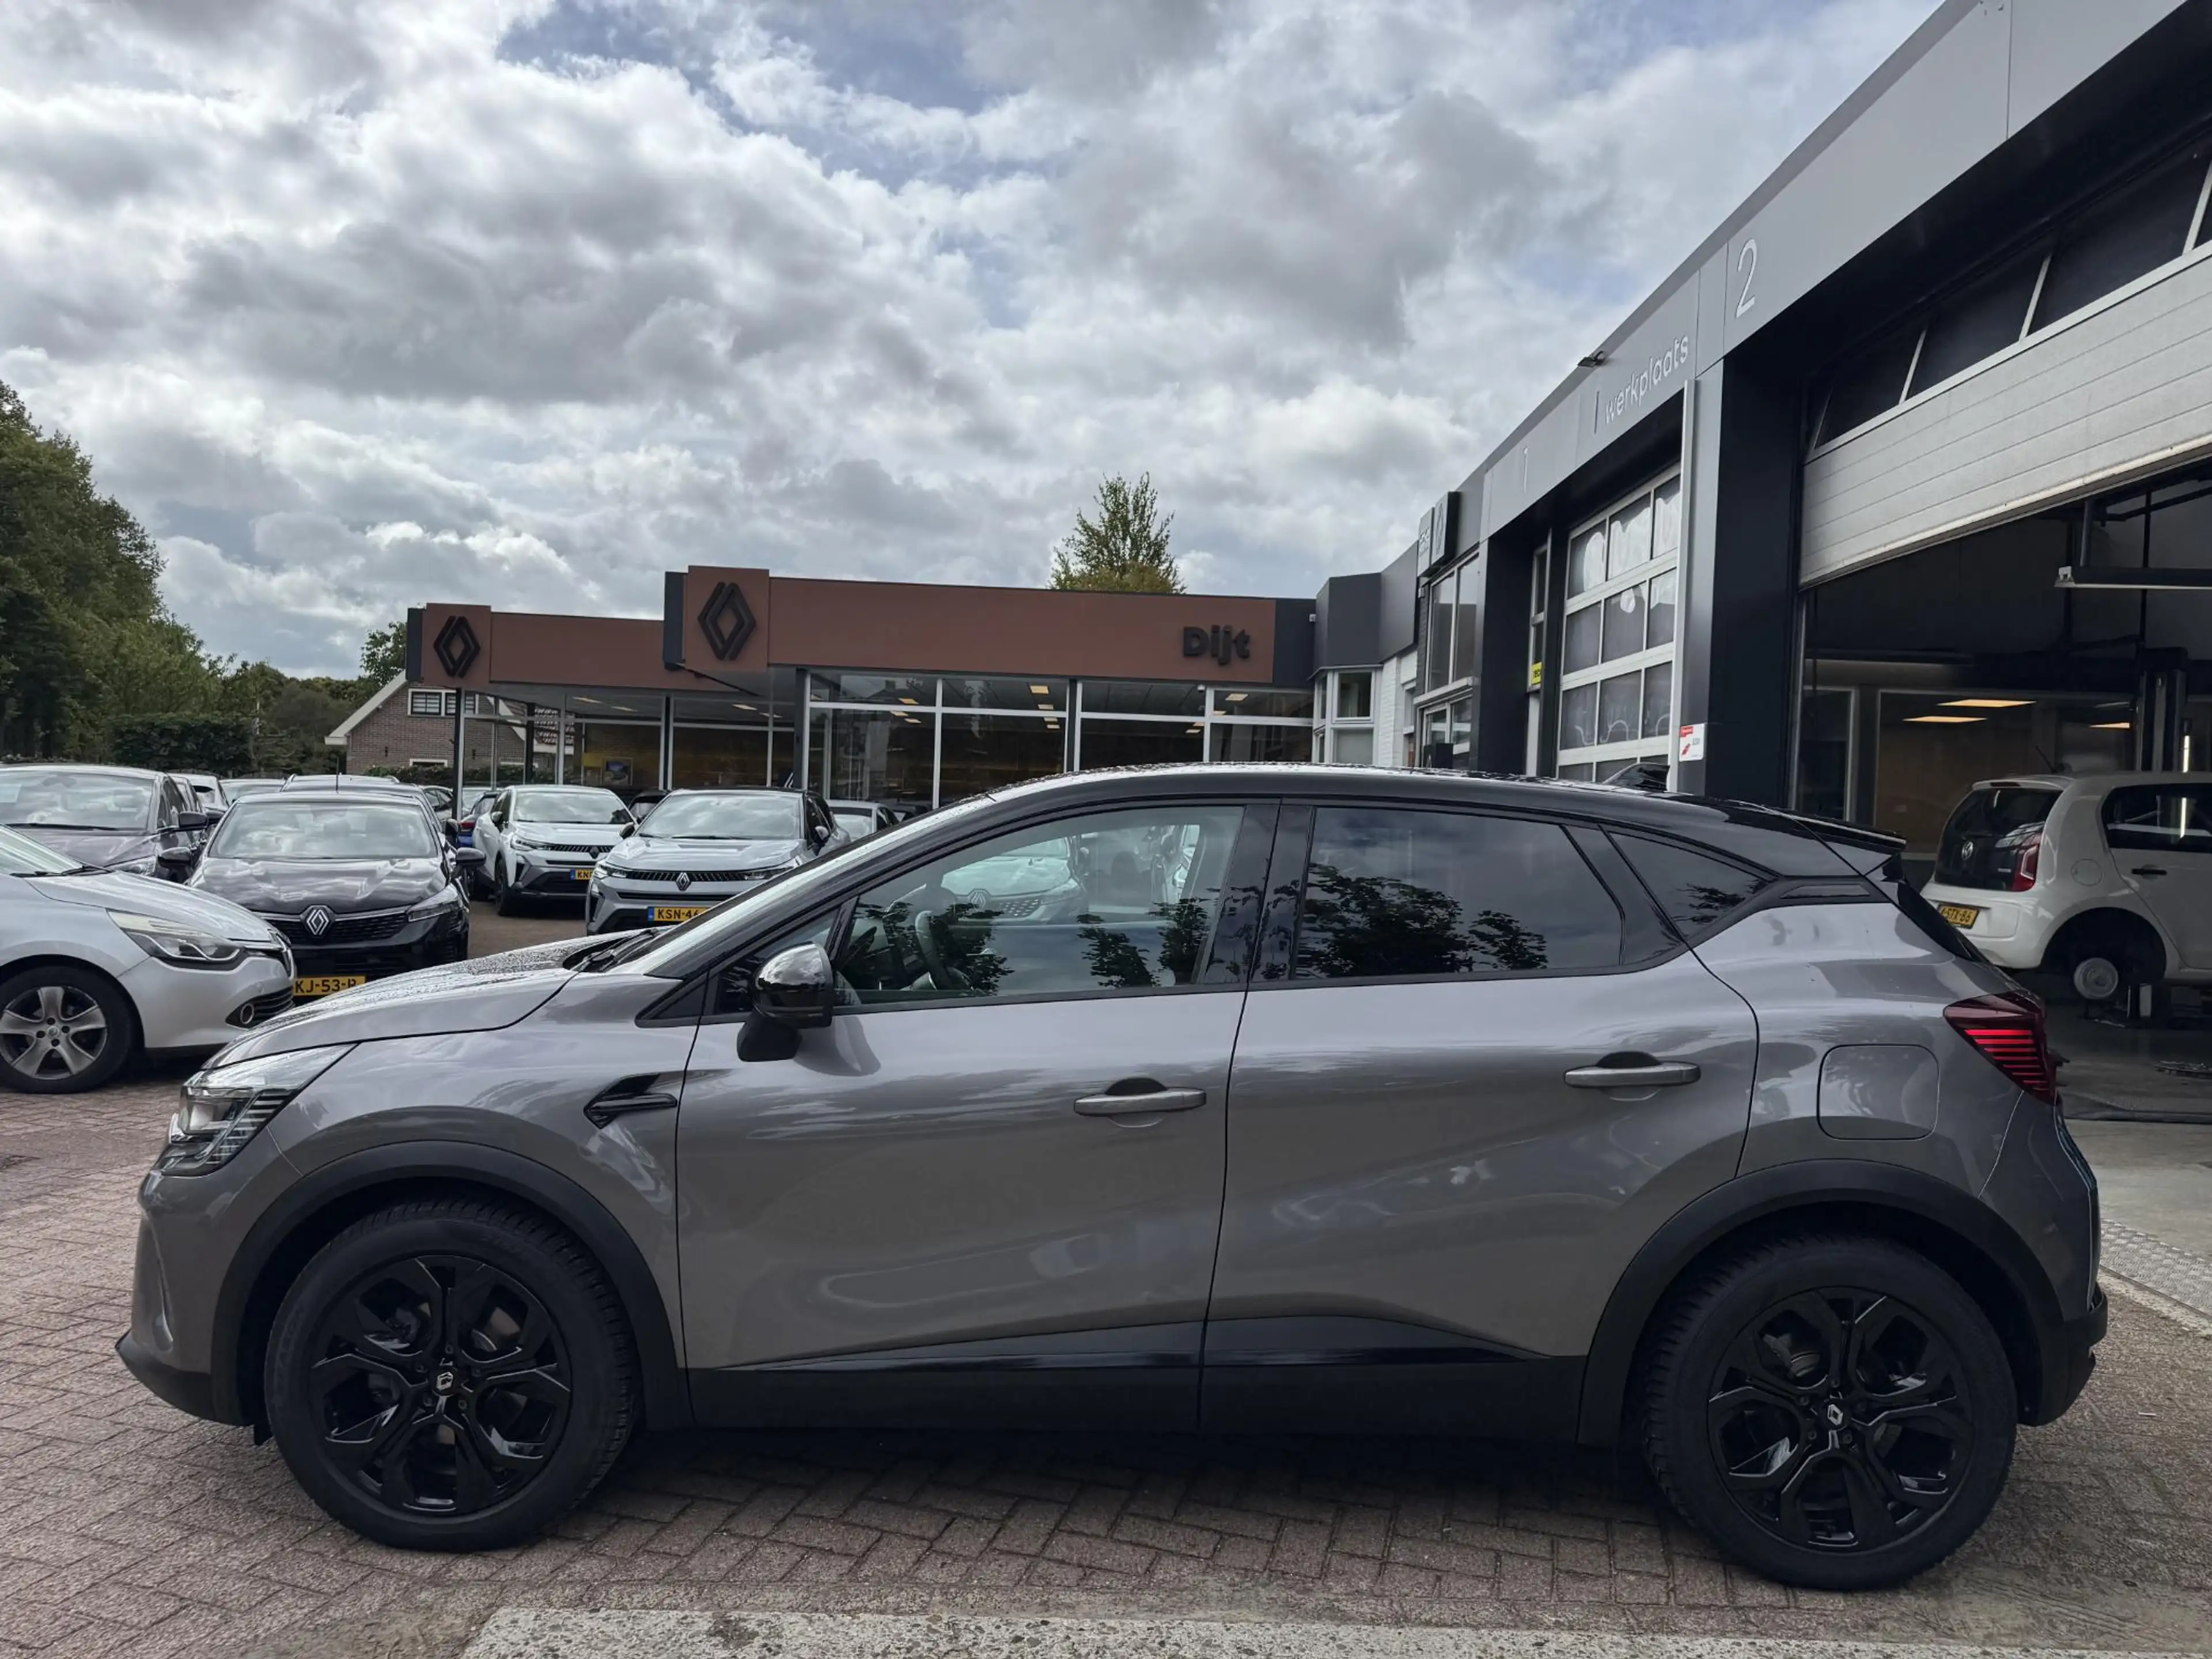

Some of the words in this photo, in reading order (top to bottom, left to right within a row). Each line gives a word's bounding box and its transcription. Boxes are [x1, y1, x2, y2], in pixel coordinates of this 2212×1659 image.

[1735, 238, 1757, 318] 2
[1605, 335, 1688, 424] werkplaats
[1183, 624, 1251, 667] Dijt
